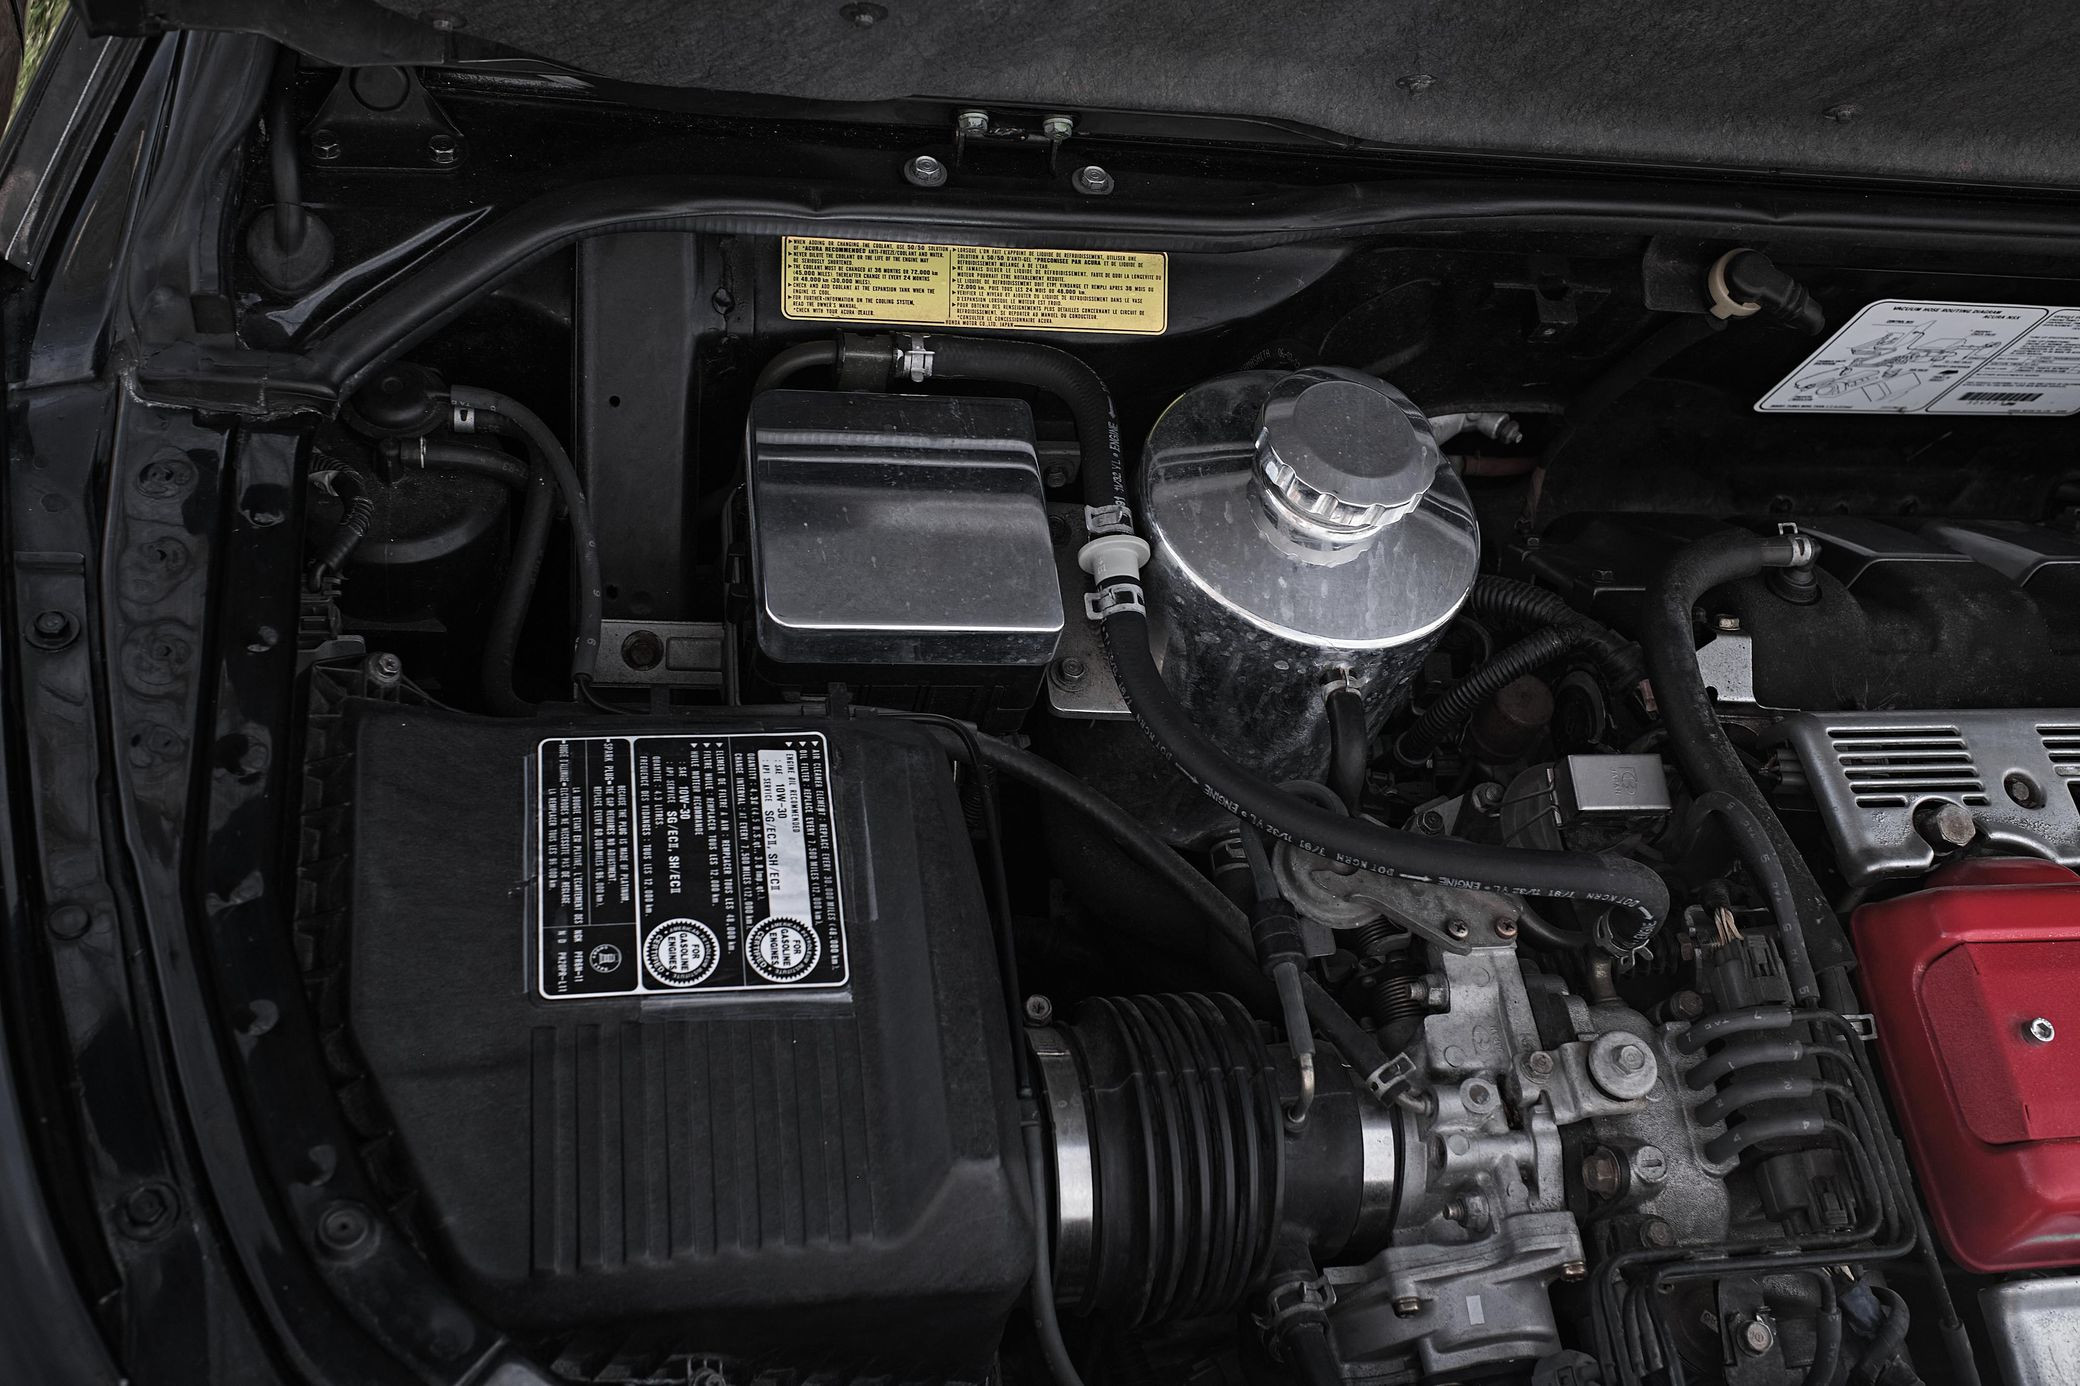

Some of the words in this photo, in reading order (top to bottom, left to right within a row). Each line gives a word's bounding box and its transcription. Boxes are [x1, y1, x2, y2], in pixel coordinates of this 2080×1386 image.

[1108, 421, 1121, 453] ENGINE
[603, 742, 613, 761] SPARK
[690, 750, 699, 766] HUILE
[702, 750, 712, 768] FILTRE
[798, 749, 808, 759] OIL
[811, 749, 820, 759] AIR
[639, 755, 648, 786] FREQUENCE
[652, 755, 661, 782] QUANTITE
[665, 766, 674, 776] API
[678, 766, 687, 776] SAE
[715, 750, 725, 774] ELEMENT
[734, 752, 743, 773] CHANGE
[746, 752, 756, 779] QUANTITY
[762, 764, 770, 773] API
[774, 764, 783, 774] SAE
[785, 753, 795, 773] ENGINE
[604, 765, 614, 781] PLUG
[704, 772, 713, 789] HUILE
[788, 776, 796, 785] OIL
[800, 762, 810, 782] FILTER
[812, 762, 823, 787] CLEANER
[593, 785, 602, 806] REPLACE
[605, 785, 614, 794] THE
[617, 784, 626, 805] BECAUSE
[640, 790, 649, 801] DES
[666, 780, 675, 802] SERVICE
[718, 788, 727, 808] FILTRE
[735, 777, 746, 804] INTERVAL
[762, 777, 772, 801] SERVICE
[1203, 784, 1240, 812] ENGINE
[605, 796, 614, 806] GAP
[678, 786, 690, 819] 10W-30
[775, 783, 787, 818] 10W-30
[802, 788, 813, 812] REPLACE
[815, 790, 826, 815] ELEMENT
[593, 809, 602, 824] EVERY
[618, 808, 627, 817] THE
[640, 804, 651, 835] VIDANGES
[706, 797, 716, 830] REMPLACER
[789, 789, 800, 832] RECOMMENDED
[605, 809, 615, 835] REQUIRES
[618, 820, 627, 835] PLUG
[720, 819, 729, 830] AIR
[738, 821, 748, 840] EVERY
[805, 816, 815, 836] EVERY
[548, 829, 557, 841] TOUS
[707, 834, 717, 850] TOUS
[818, 823, 829, 849] REPLACE
[548, 844, 557, 854] LES
[594, 850, 603, 866] MILES
[618, 846, 628, 861] MADE
[642, 844, 652, 859] TOUS
[721, 839, 732, 874] REMPLACER
[642, 863, 652, 874] LES
[708, 853, 718, 865] LES
[821, 852, 831, 871] EVERY
[741, 865, 751, 884] MILES
[809, 861, 819, 880] MILES
[723, 878, 733, 893] TOUS
[1438, 876, 1482, 890] ENGINE
[724, 897, 734, 909] LES
[825, 901, 836, 920] MILES
[650, 934, 664, 972] CERTIFIED
[667, 936, 677, 970] ENGINES
[679, 932, 688, 970] GASOLINE
[751, 930, 767, 968] CERTIFIED
[769, 932, 779, 965] ENGINES
[780, 928, 790, 966] GASOLINE
[792, 939, 801, 954] FOR
